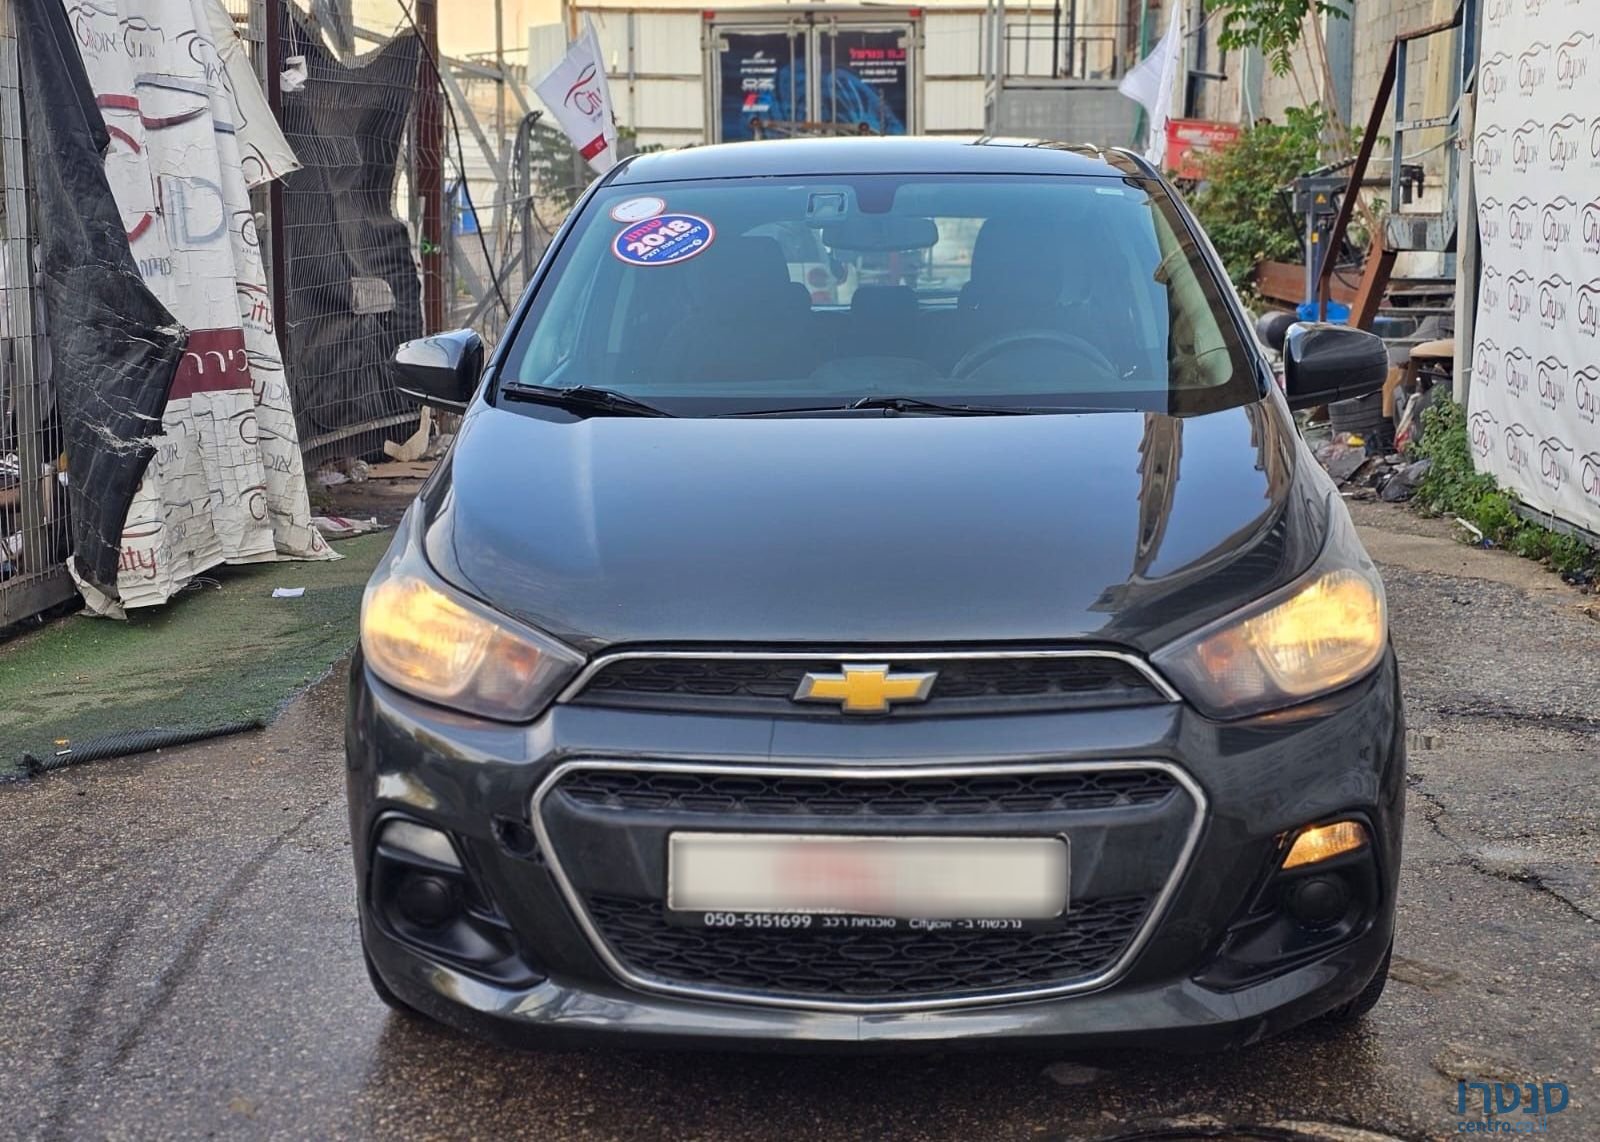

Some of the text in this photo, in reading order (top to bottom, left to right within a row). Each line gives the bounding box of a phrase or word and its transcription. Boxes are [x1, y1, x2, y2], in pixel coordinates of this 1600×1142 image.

[627, 220, 692, 257] 2018
[118, 546, 157, 579] ity
[704, 912, 813, 928] 050-5151699
[822, 916, 848, 928] רכב
[977, 918, 1022, 929] נרכשתי
